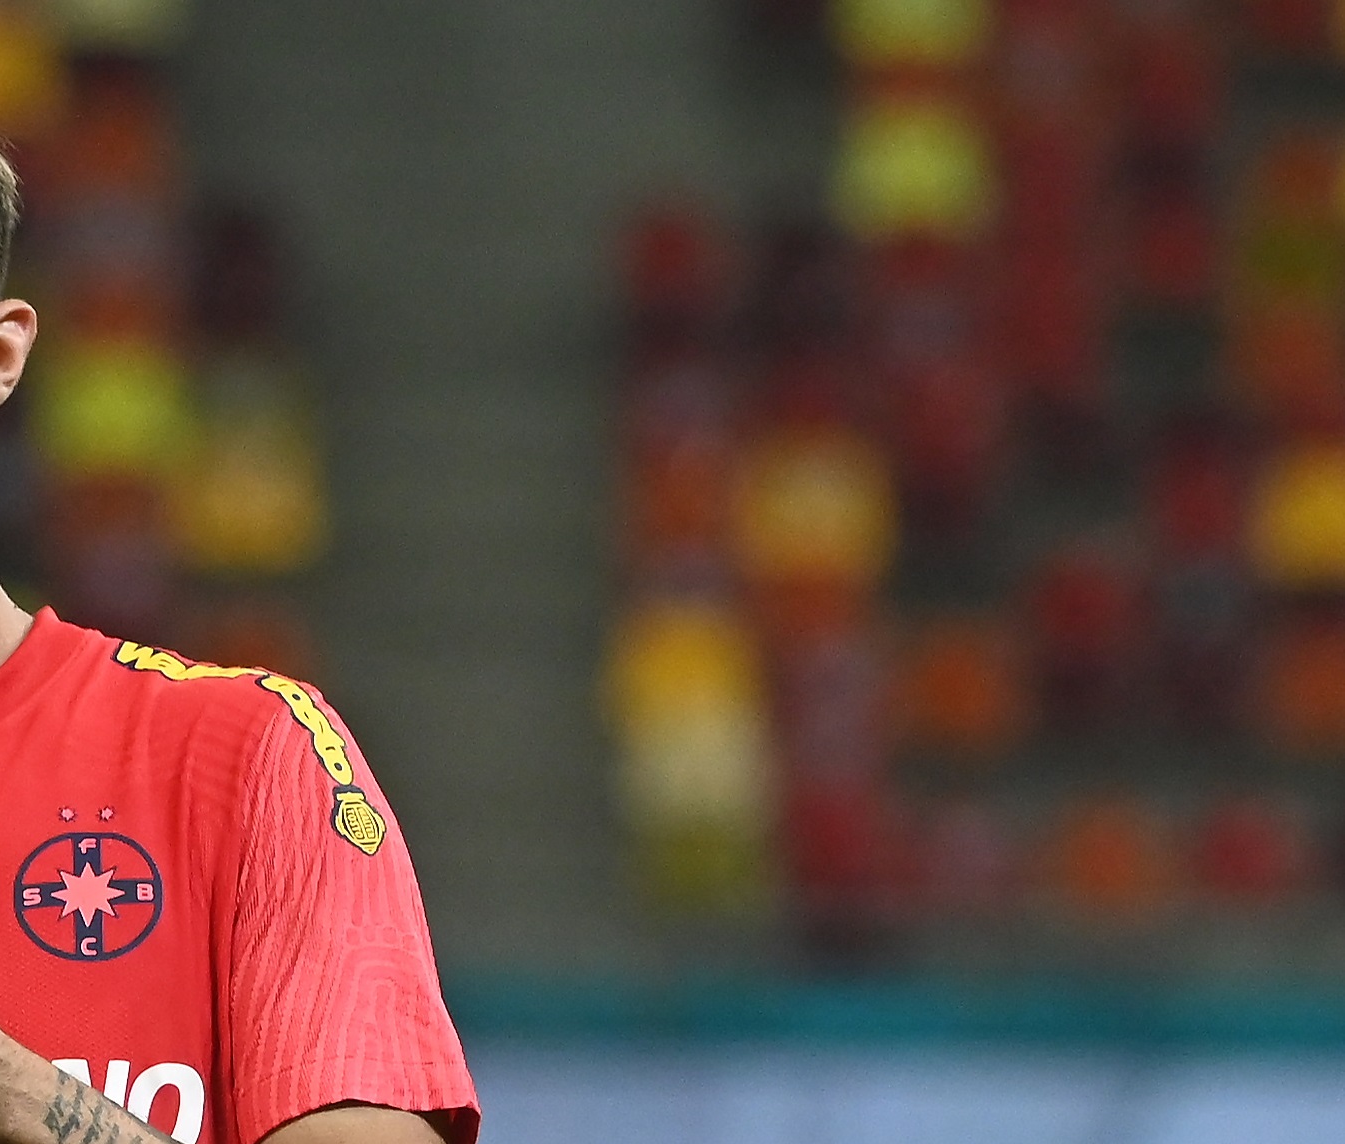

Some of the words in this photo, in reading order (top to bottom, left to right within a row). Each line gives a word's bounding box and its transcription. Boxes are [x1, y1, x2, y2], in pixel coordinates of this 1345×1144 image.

[77, 837, 97, 855] F
[22, 886, 42, 906] S
[136, 883, 154, 901] B
[80, 937, 98, 957] C
